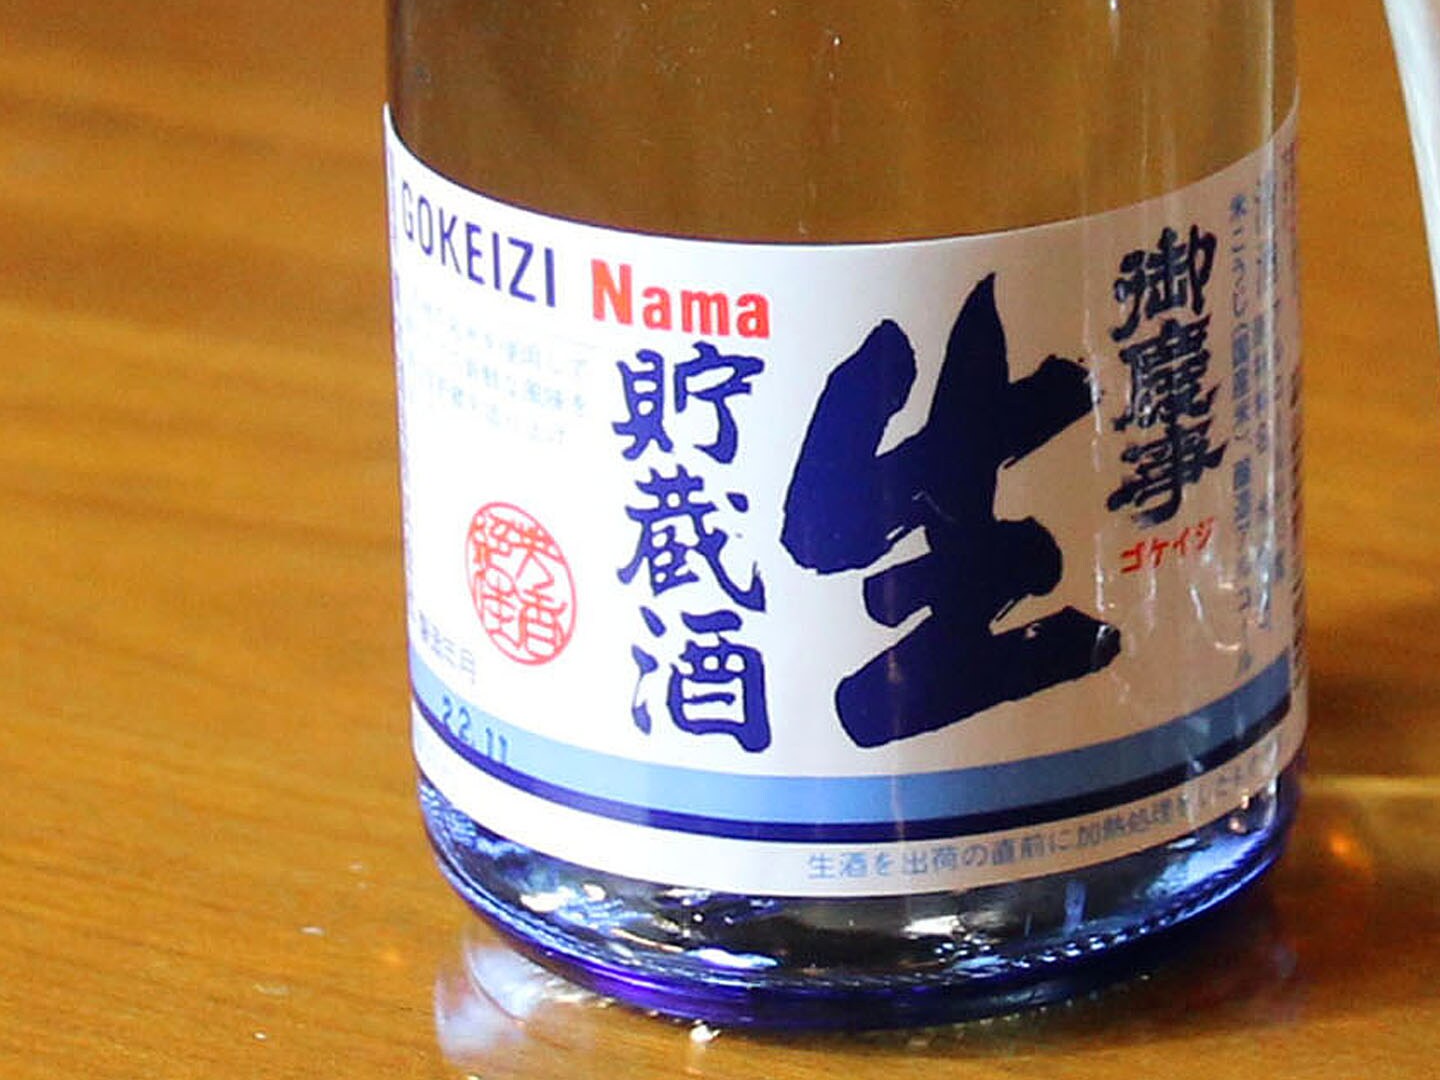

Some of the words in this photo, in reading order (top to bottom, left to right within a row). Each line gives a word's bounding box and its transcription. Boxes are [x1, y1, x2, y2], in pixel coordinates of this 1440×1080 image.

[402, 180, 556, 309] GOKEIZI
[590, 257, 771, 340] Nama
[1110, 223, 1229, 528] 御慶事
[612, 340, 772, 754] 貯蔵酒
[779, 272, 1122, 749] 生
[1121, 516, 1214, 574] ゴケイジ
